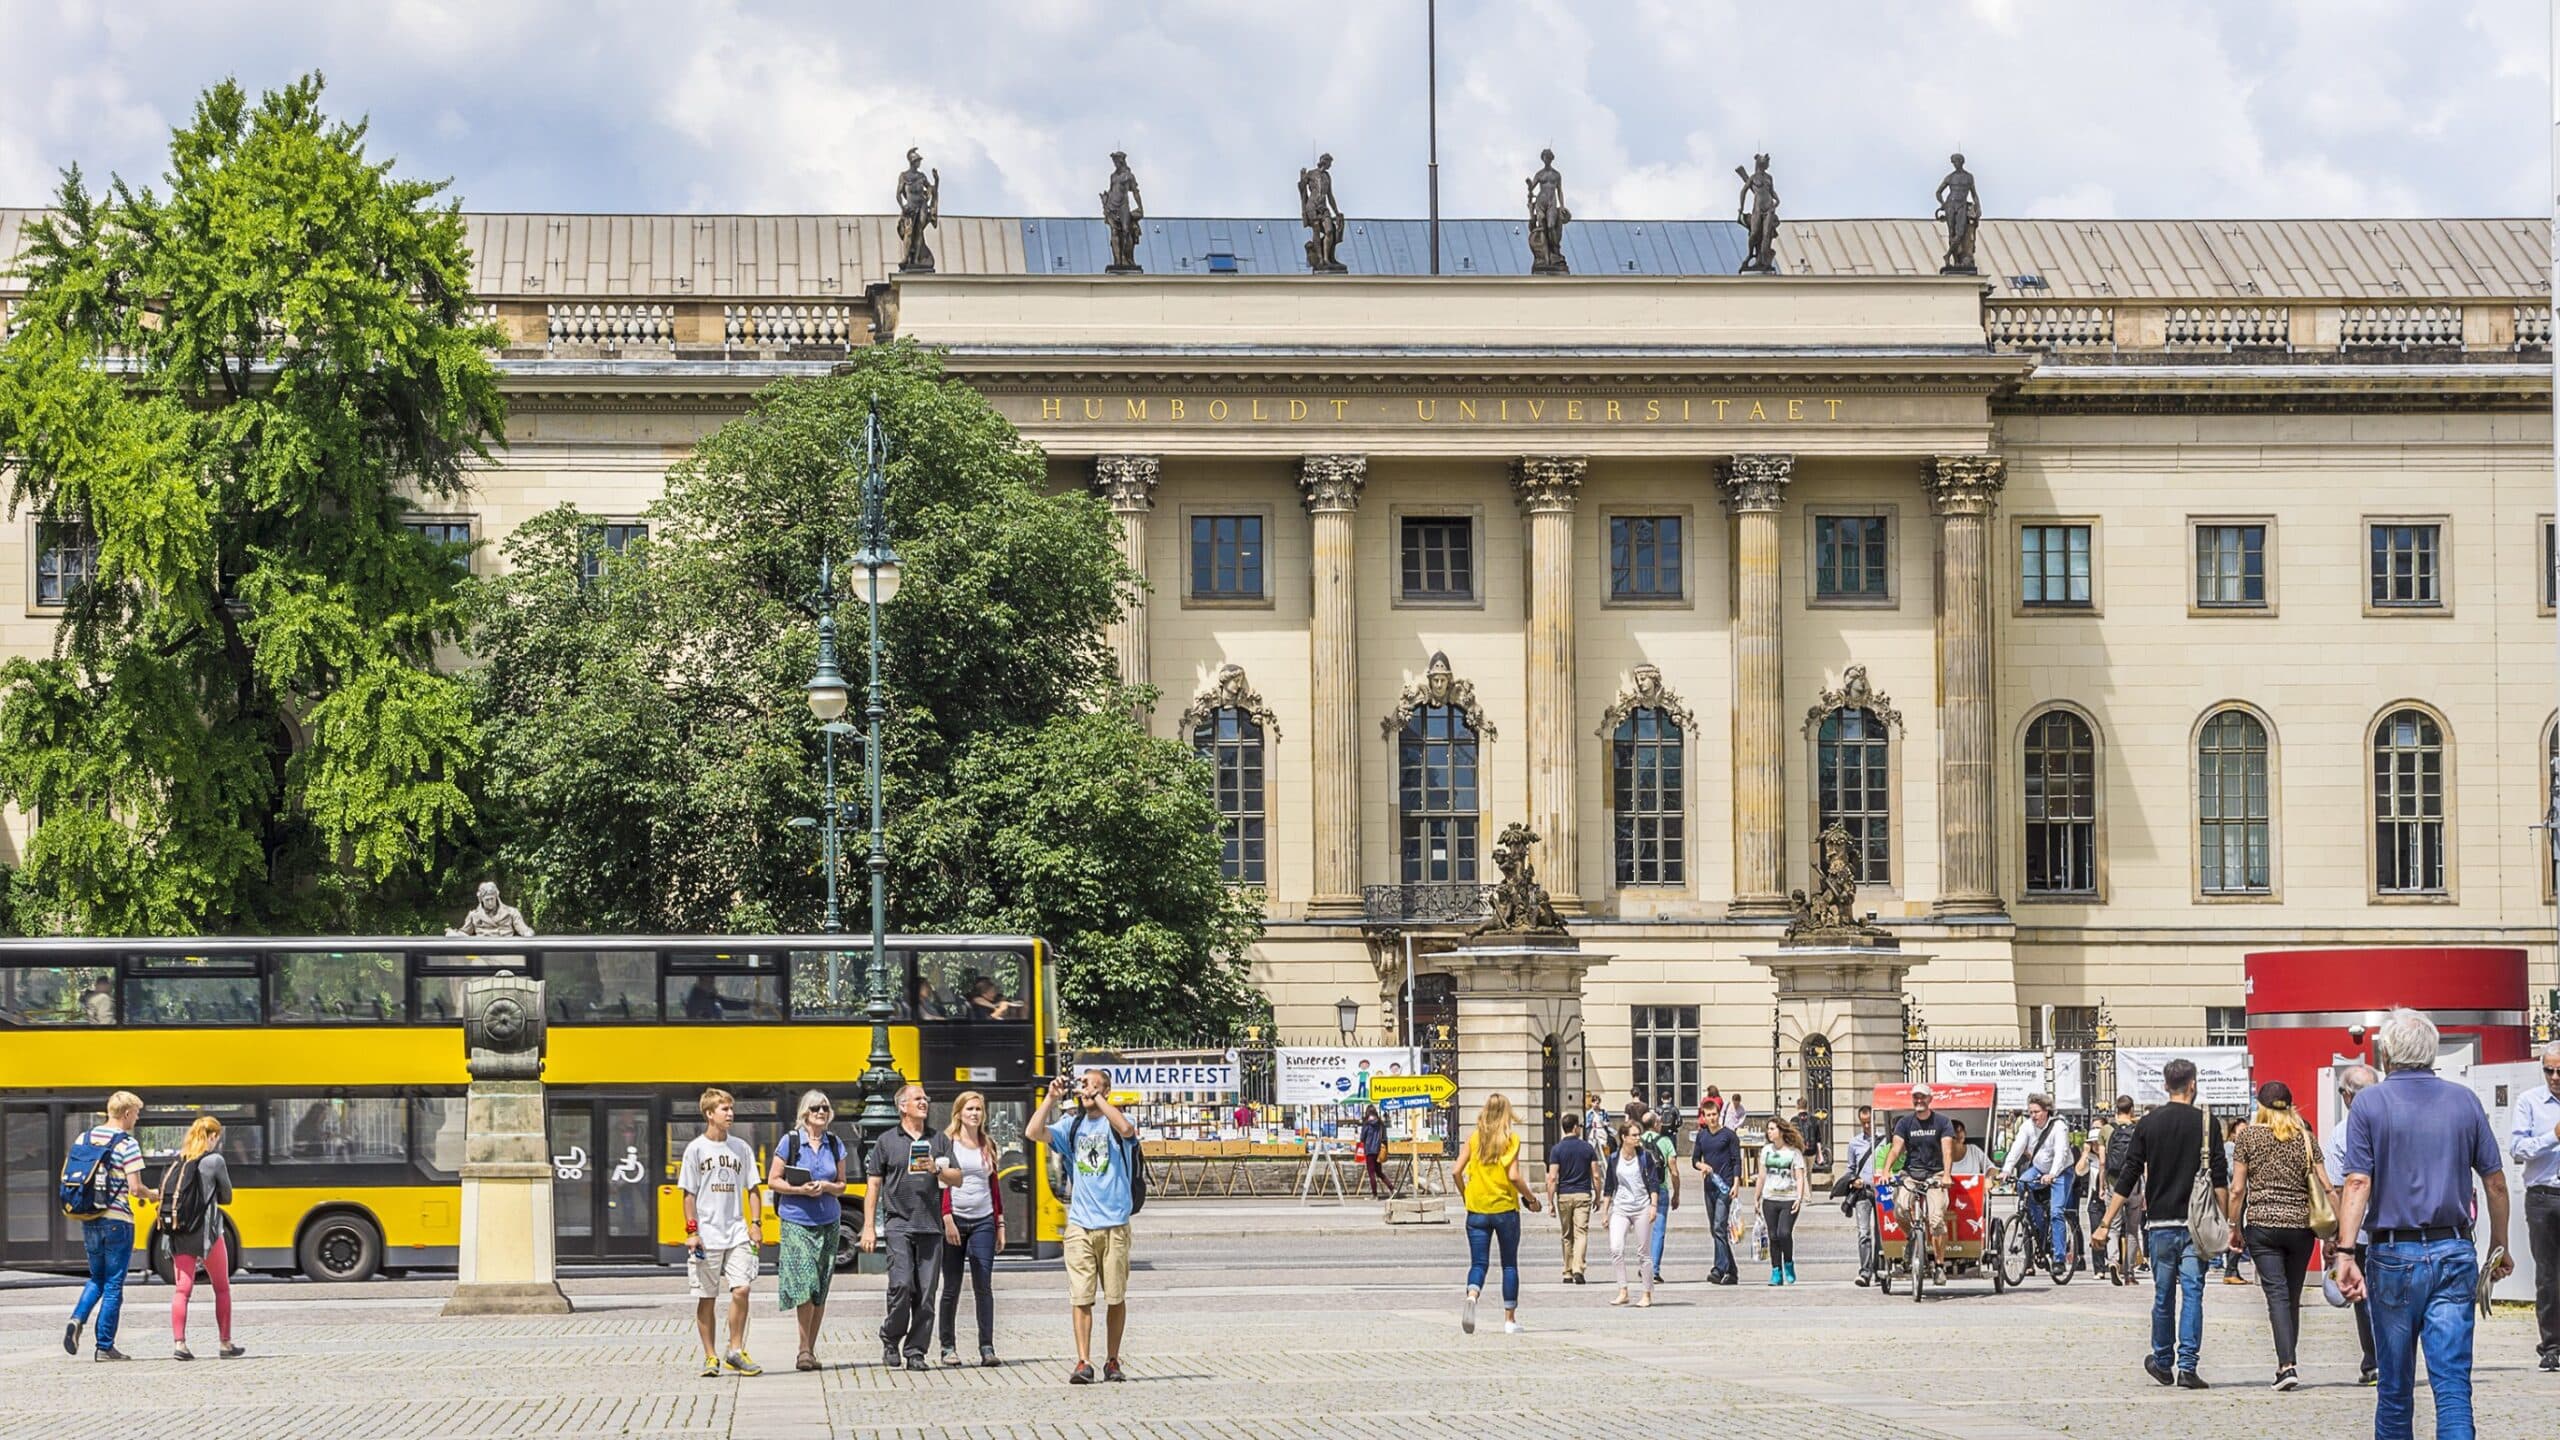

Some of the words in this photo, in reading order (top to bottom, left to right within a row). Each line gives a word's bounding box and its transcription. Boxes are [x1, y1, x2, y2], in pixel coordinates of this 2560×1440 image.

[1041, 399, 1349, 421] HUMBOLDT
[1416, 400, 1842, 421] UNIVERSITAET
[1999, 1069, 2037, 1078] Weltkrieg
[1374, 1085, 1421, 1093] Mauerpark
[711, 1184, 735, 1193] COLLEGE
